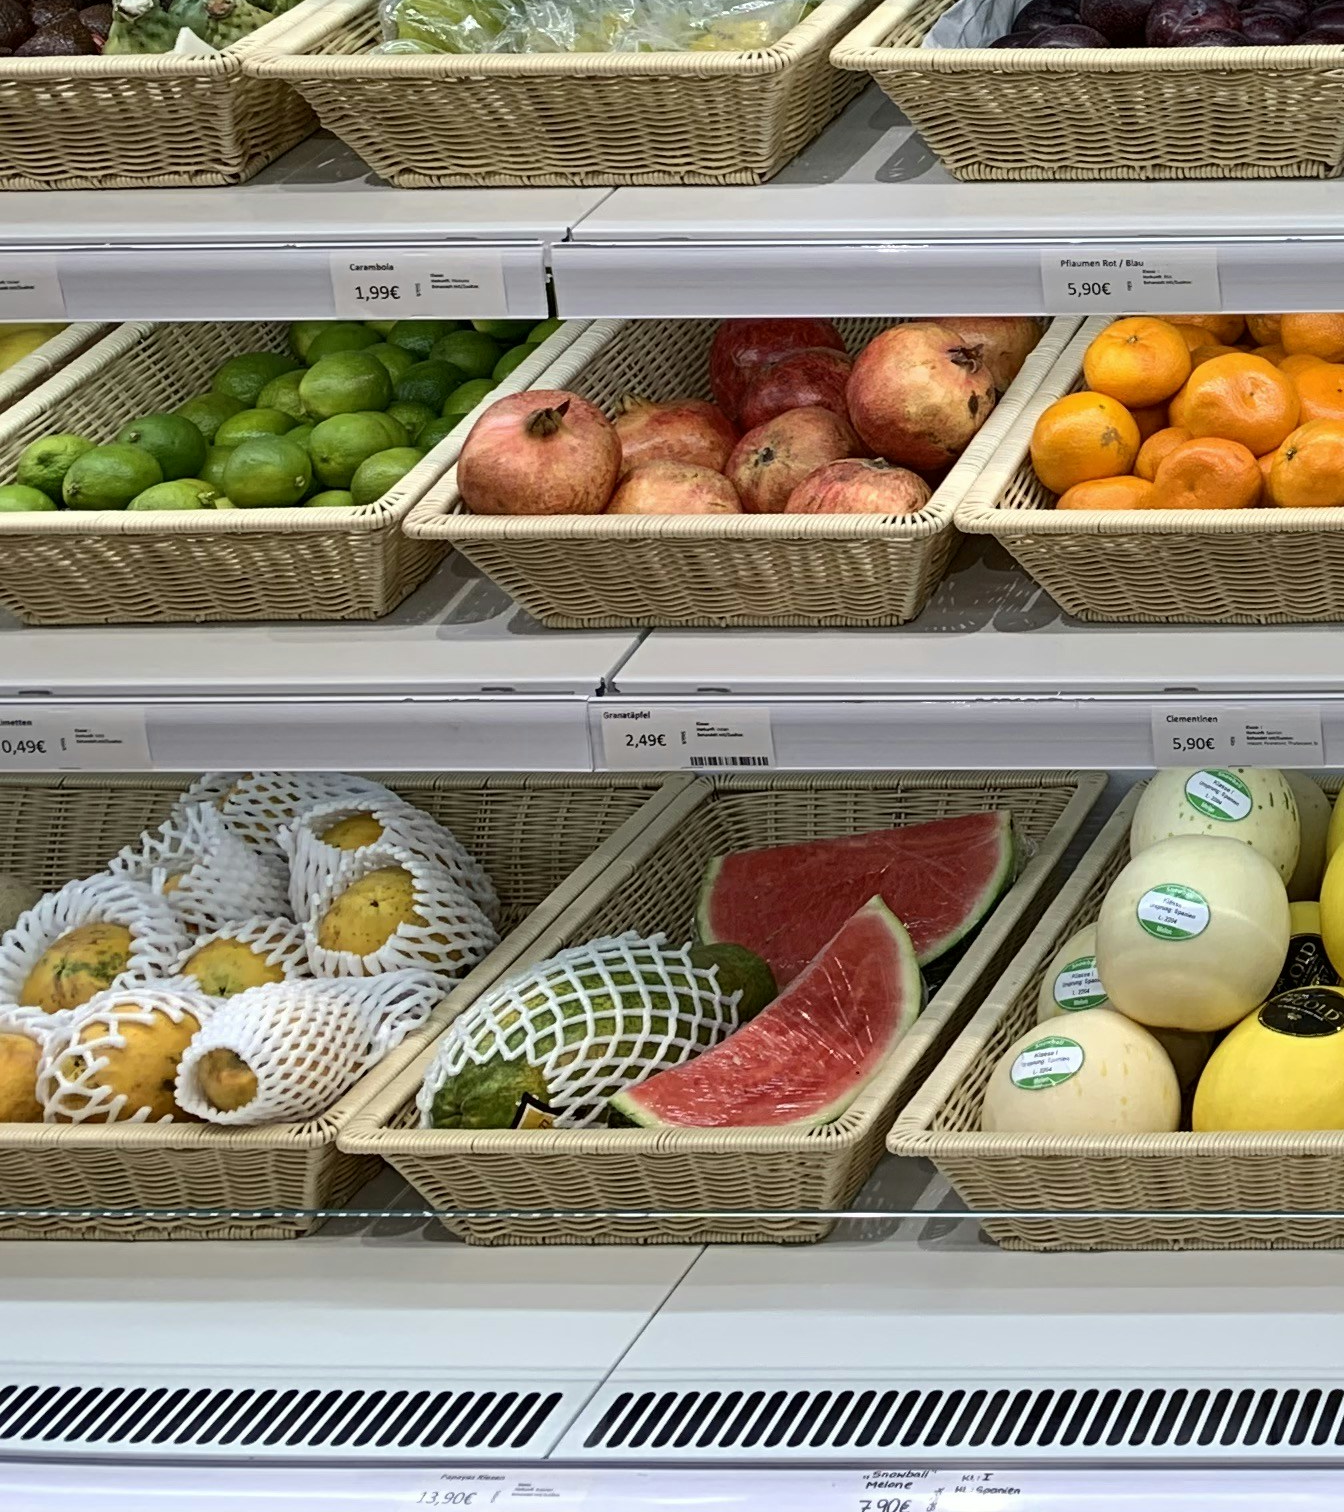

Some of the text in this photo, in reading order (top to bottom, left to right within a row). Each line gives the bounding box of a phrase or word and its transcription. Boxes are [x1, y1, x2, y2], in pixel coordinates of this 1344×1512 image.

[350, 263, 393, 271] Carambola
[355, 286, 400, 301] 1,99€
[1068, 283, 1111, 297] 5,90€
[604, 711, 650, 720] Granatäpfel
[2, 740, 46, 755] 0,49€
[626, 734, 666, 748] 2,49€
[1173, 738, 1215, 751] 5,90€
[1289, 942, 1316, 978] OLD
[1292, 996, 1339, 1020] GOLD
[865, 1481, 914, 1489] Melone
[417, 1492, 477, 1505] 13,90€
[859, 1498, 913, 1512] 790€
